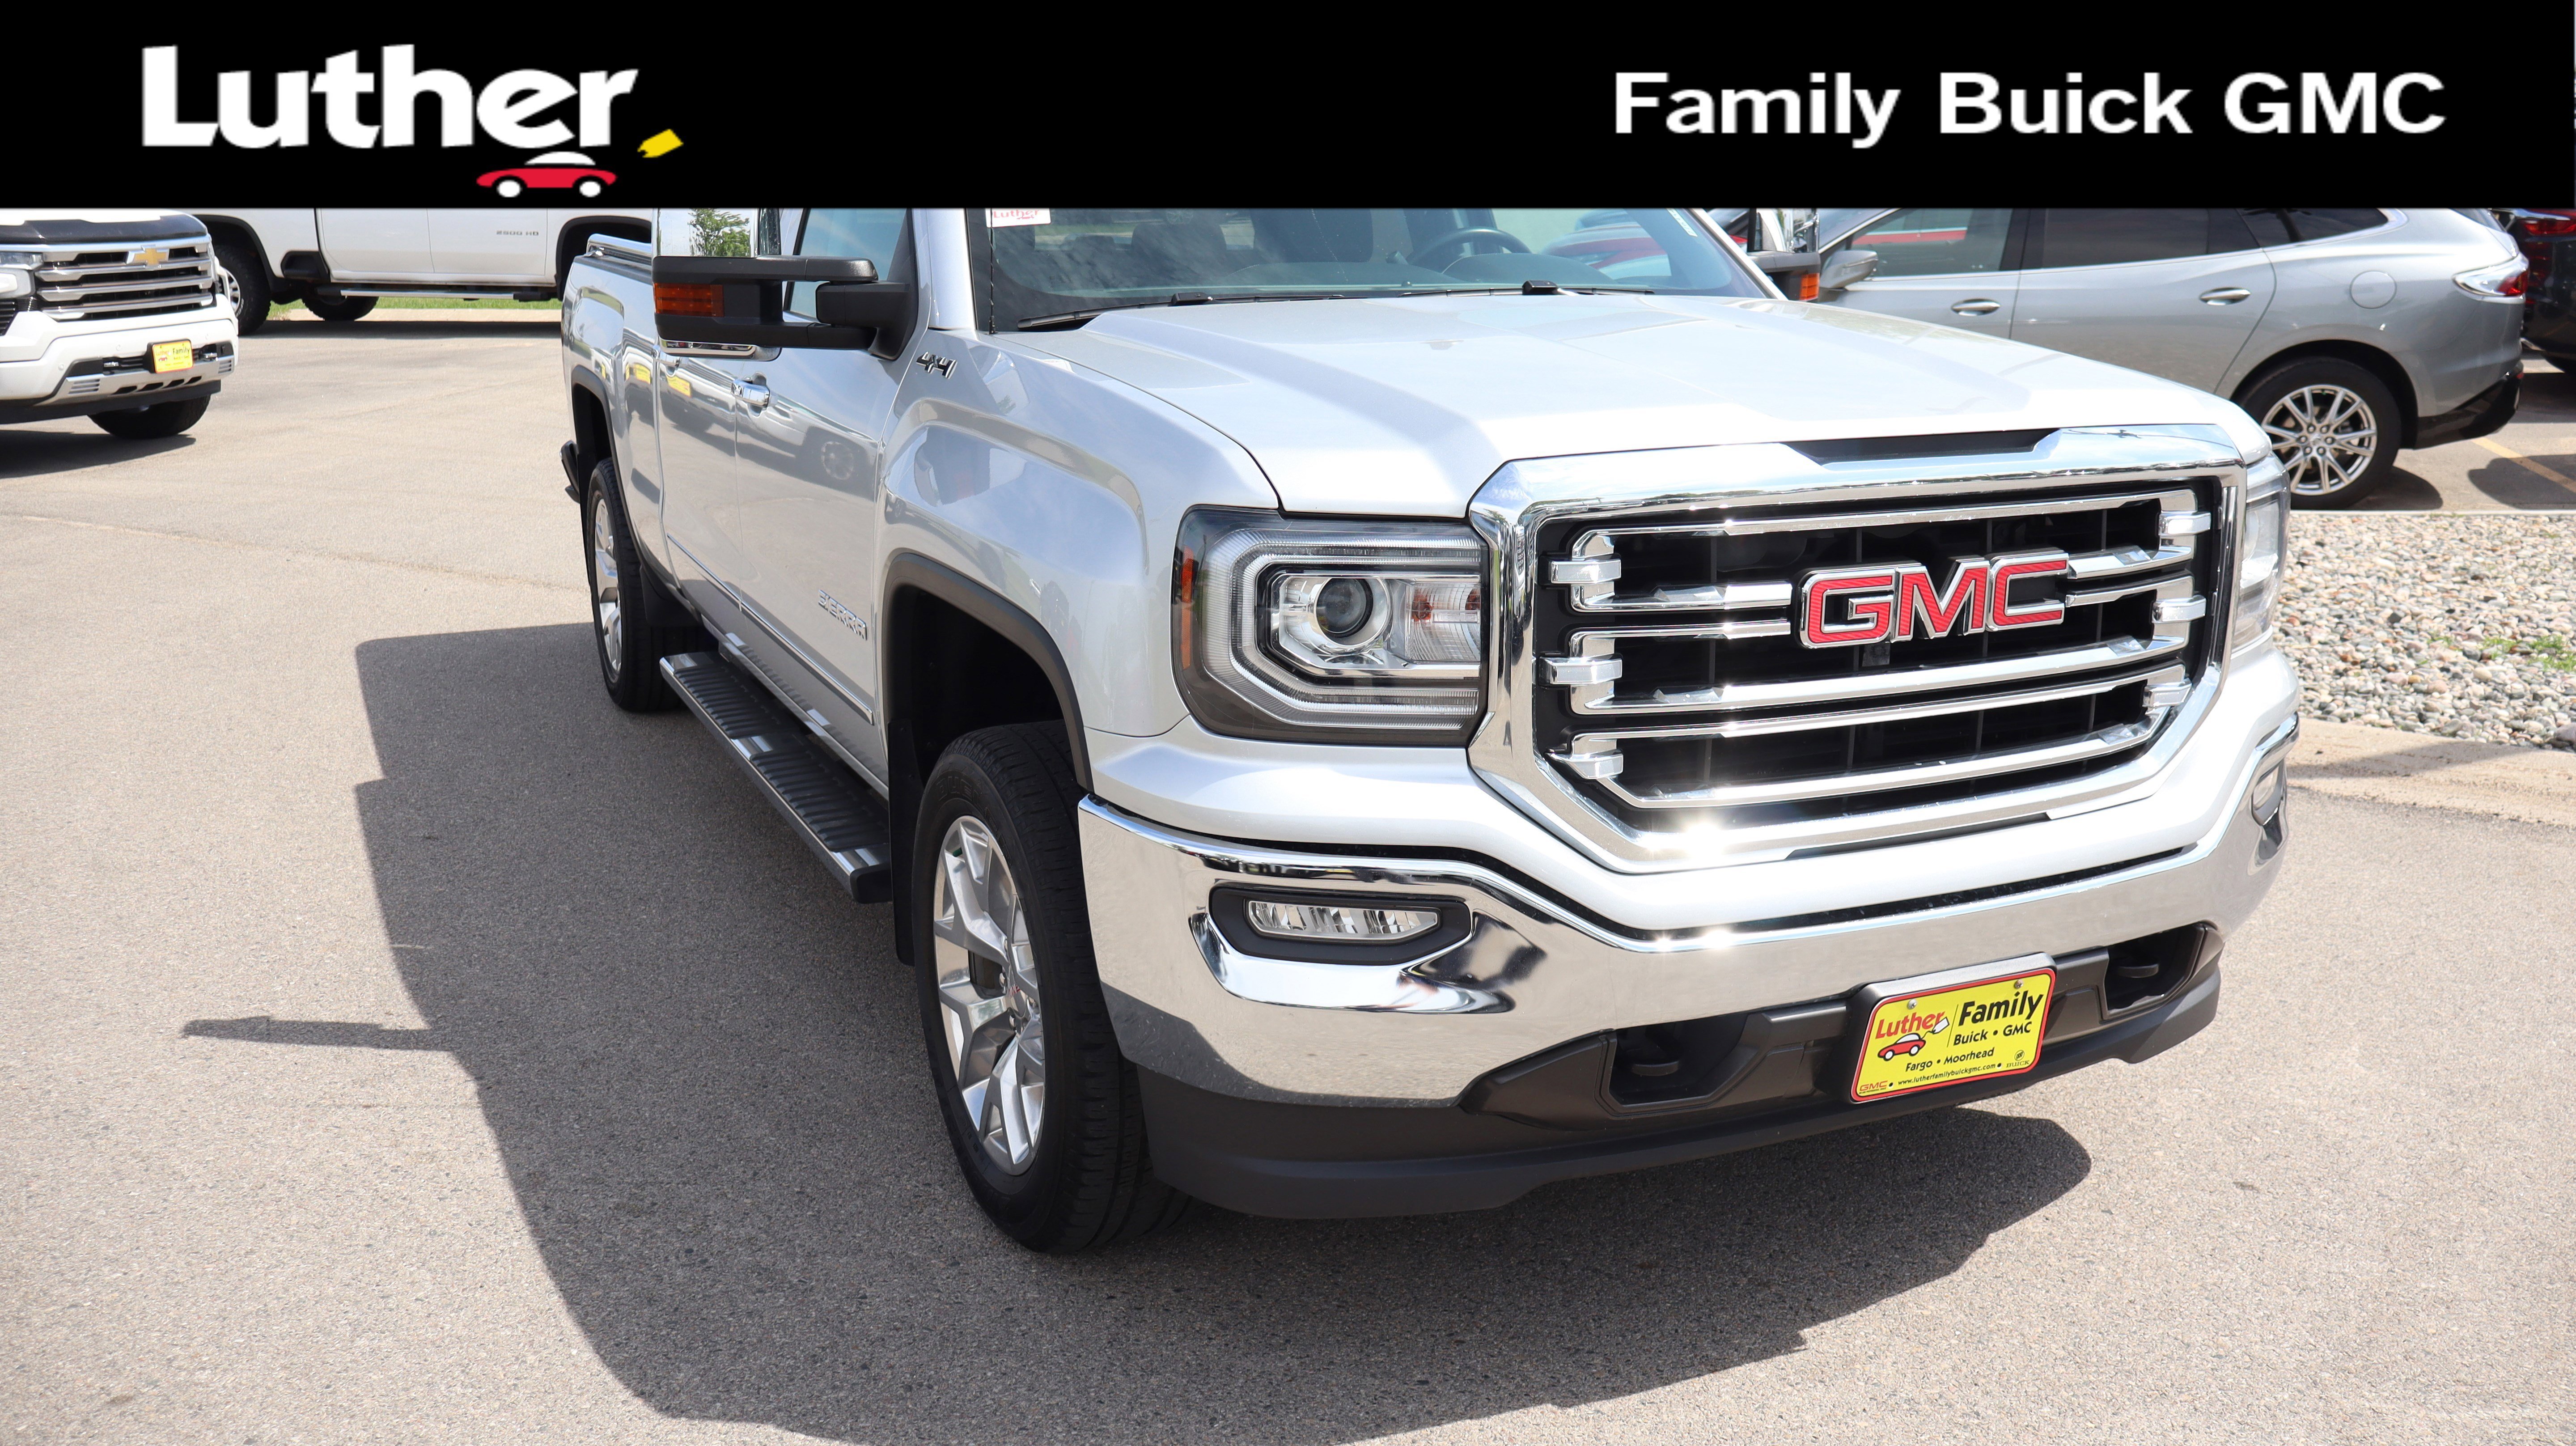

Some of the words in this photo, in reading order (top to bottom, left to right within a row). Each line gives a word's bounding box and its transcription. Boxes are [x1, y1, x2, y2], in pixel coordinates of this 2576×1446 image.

[993, 208, 1039, 218] Luther
[173, 347, 190, 355] Family
[1800, 552, 2069, 649] GMC
[818, 589, 867, 640] SIERRA
[1958, 990, 2044, 1026] Family
[1875, 1011, 1945, 1039] Luther
[1953, 1029, 1988, 1046] Buick
[2003, 1022, 2032, 1036] GMC
[1905, 1060, 1932, 1072] Fargo
[1943, 1047, 1995, 1065] Moorhead
[1860, 1081, 1888, 1091] GMC
[1898, 1064, 1996, 1086] www.lutherfamilybuickgmc.com
